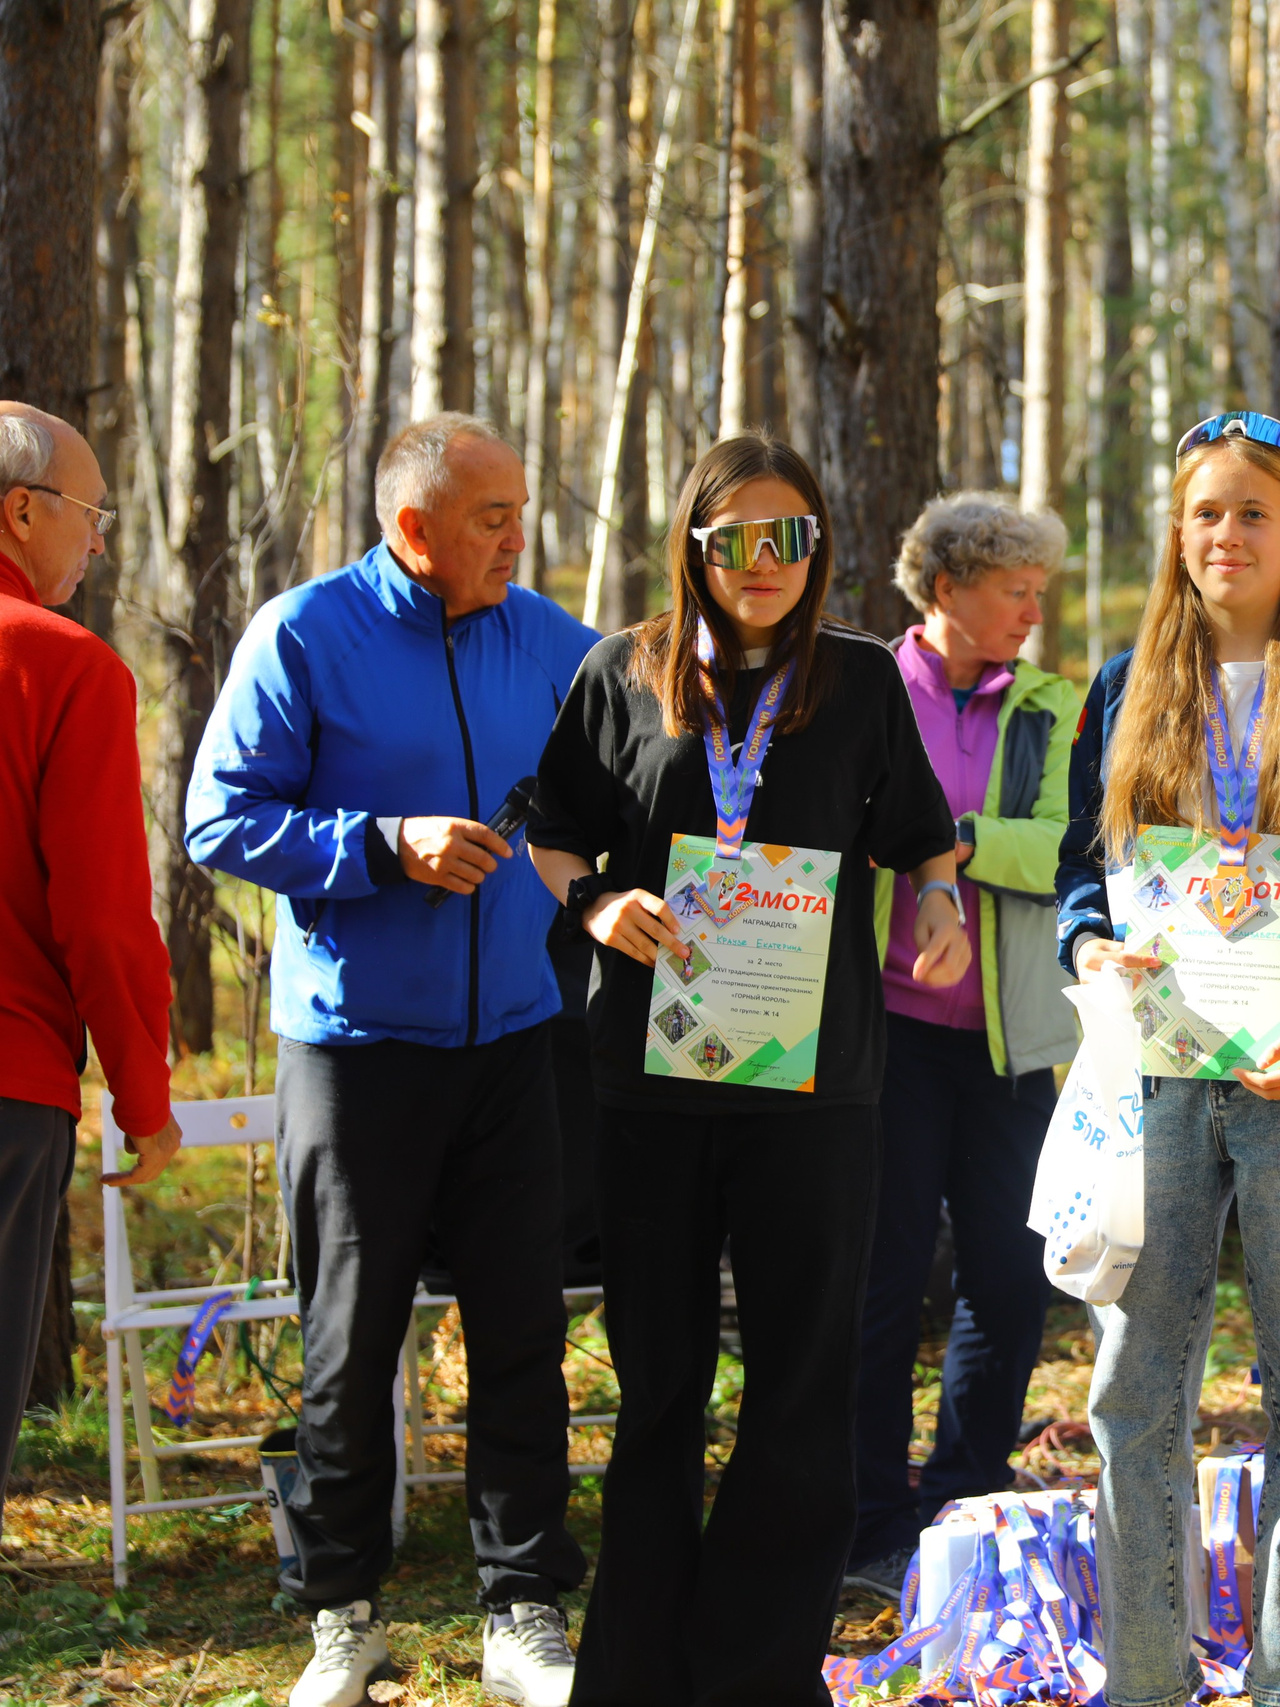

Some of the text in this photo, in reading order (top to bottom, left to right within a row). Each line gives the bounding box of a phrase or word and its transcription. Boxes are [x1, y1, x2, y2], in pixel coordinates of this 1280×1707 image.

[735, 882, 753, 902] 2
[749, 889, 828, 915] АМОТА
[1243, 887, 1255, 908] 1
[691, 889, 715, 918] ГОРНЫЙ
[727, 898, 755, 920] КОРОЛЬ
[742, 917, 797, 930] НАГРАЖДАЕТСЯ
[1195, 902, 1218, 926] ГОРНЫЙ
[1233, 904, 1261, 928] КОРОЛЬ
[757, 957, 762, 965] 2
[1196, 959, 1242, 967] традиционных
[728, 968, 772, 979] традиционных
[773, 973, 819, 983] соревнованиях
[1188, 971, 1228, 979] спортивному
[720, 980, 759, 990] спортивному
[760, 984, 813, 995] ориентированию
[731, 992, 790, 1004] «ГОРНЫЙ КОРОЛЬ»
[739, 1007, 762, 1016] группе:
[1051, 1600, 1068, 1639] ОРОЛЬ
[902, 1623, 943, 1648] КОРОЛЬ
